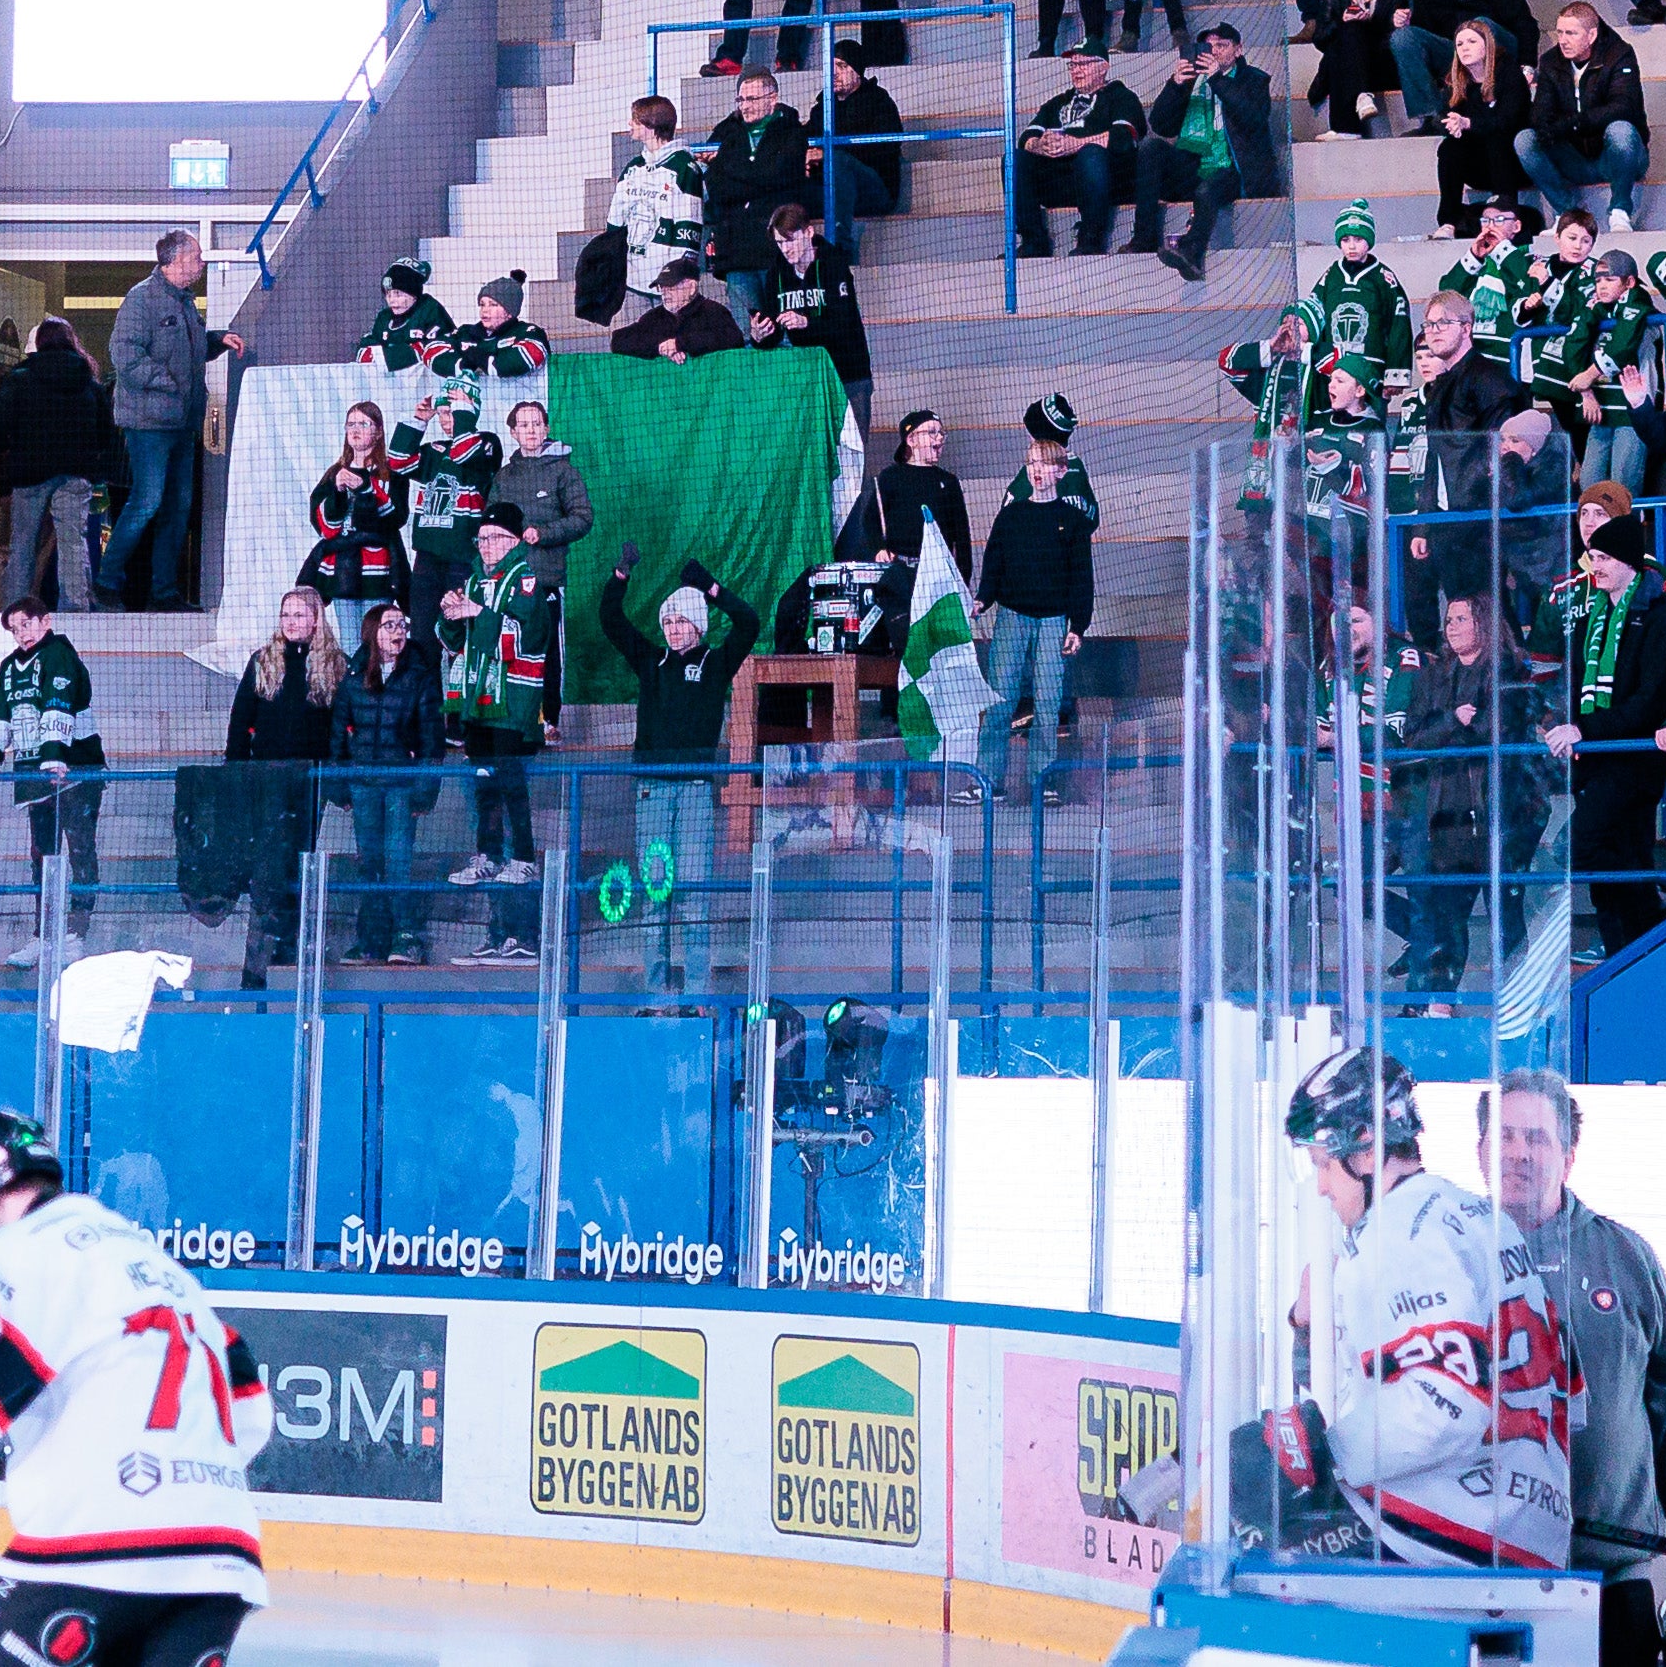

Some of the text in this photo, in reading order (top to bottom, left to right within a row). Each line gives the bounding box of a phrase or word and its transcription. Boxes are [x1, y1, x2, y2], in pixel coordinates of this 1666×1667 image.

[339, 1214, 504, 1277] Hybridge
[579, 1220, 724, 1286] Hybridge
[778, 1227, 905, 1296] Hybridge
[260, 1363, 417, 1448] 3M
[539, 1401, 700, 1457] GOTLANDS
[778, 1416, 916, 1476] GOTLANDS
[538, 1456, 700, 1513] BYGGEN AB
[778, 1473, 917, 1535] BYGGEN AB
